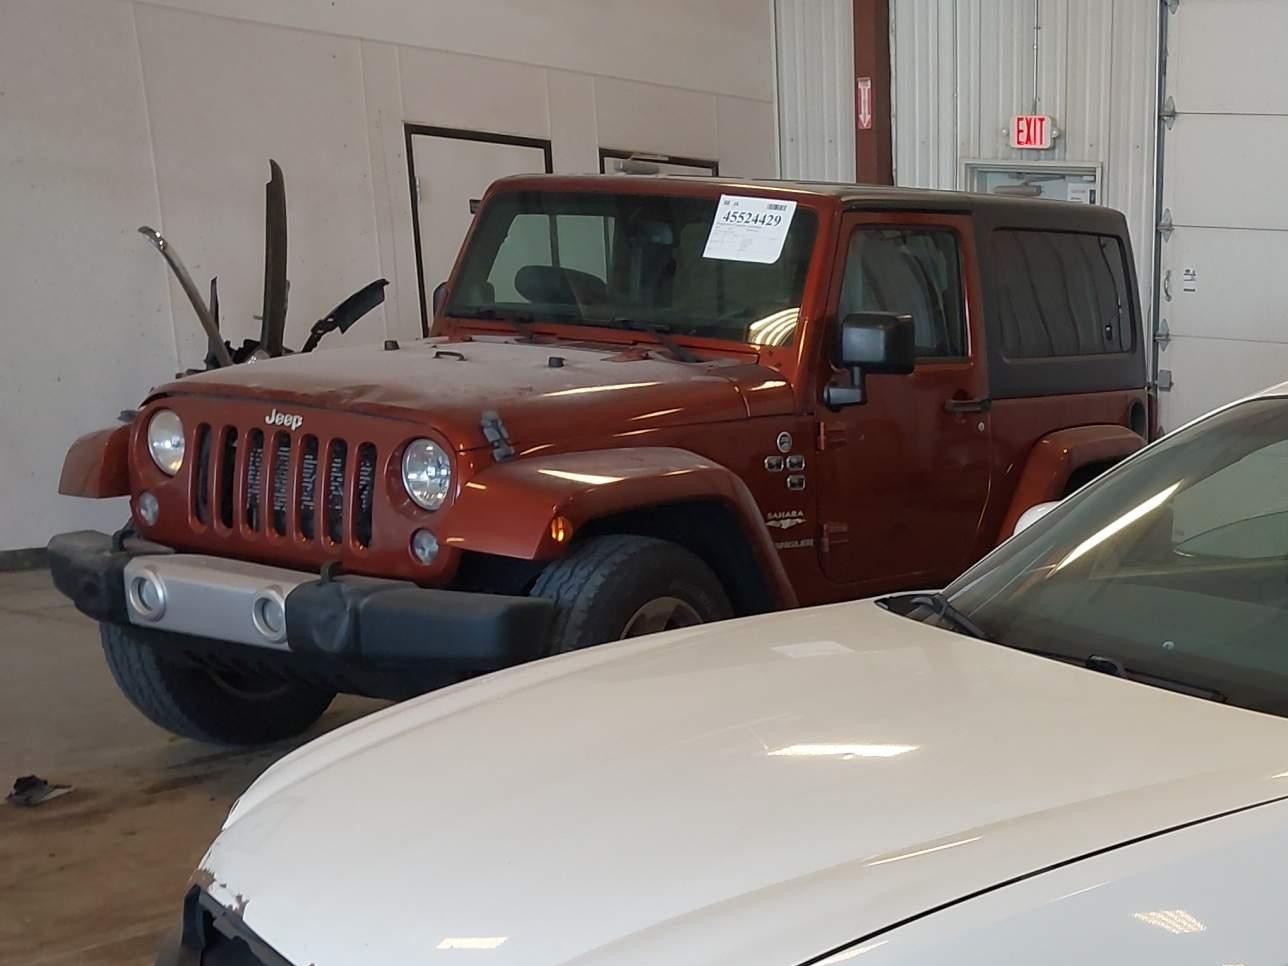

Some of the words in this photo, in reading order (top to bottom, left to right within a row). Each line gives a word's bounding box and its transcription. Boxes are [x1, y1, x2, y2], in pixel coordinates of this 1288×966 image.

[1016, 116, 1046, 146] EXIT
[722, 210, 782, 227] 45524429
[264, 408, 304, 431] Jeep
[767, 510, 804, 519] SAHARA
